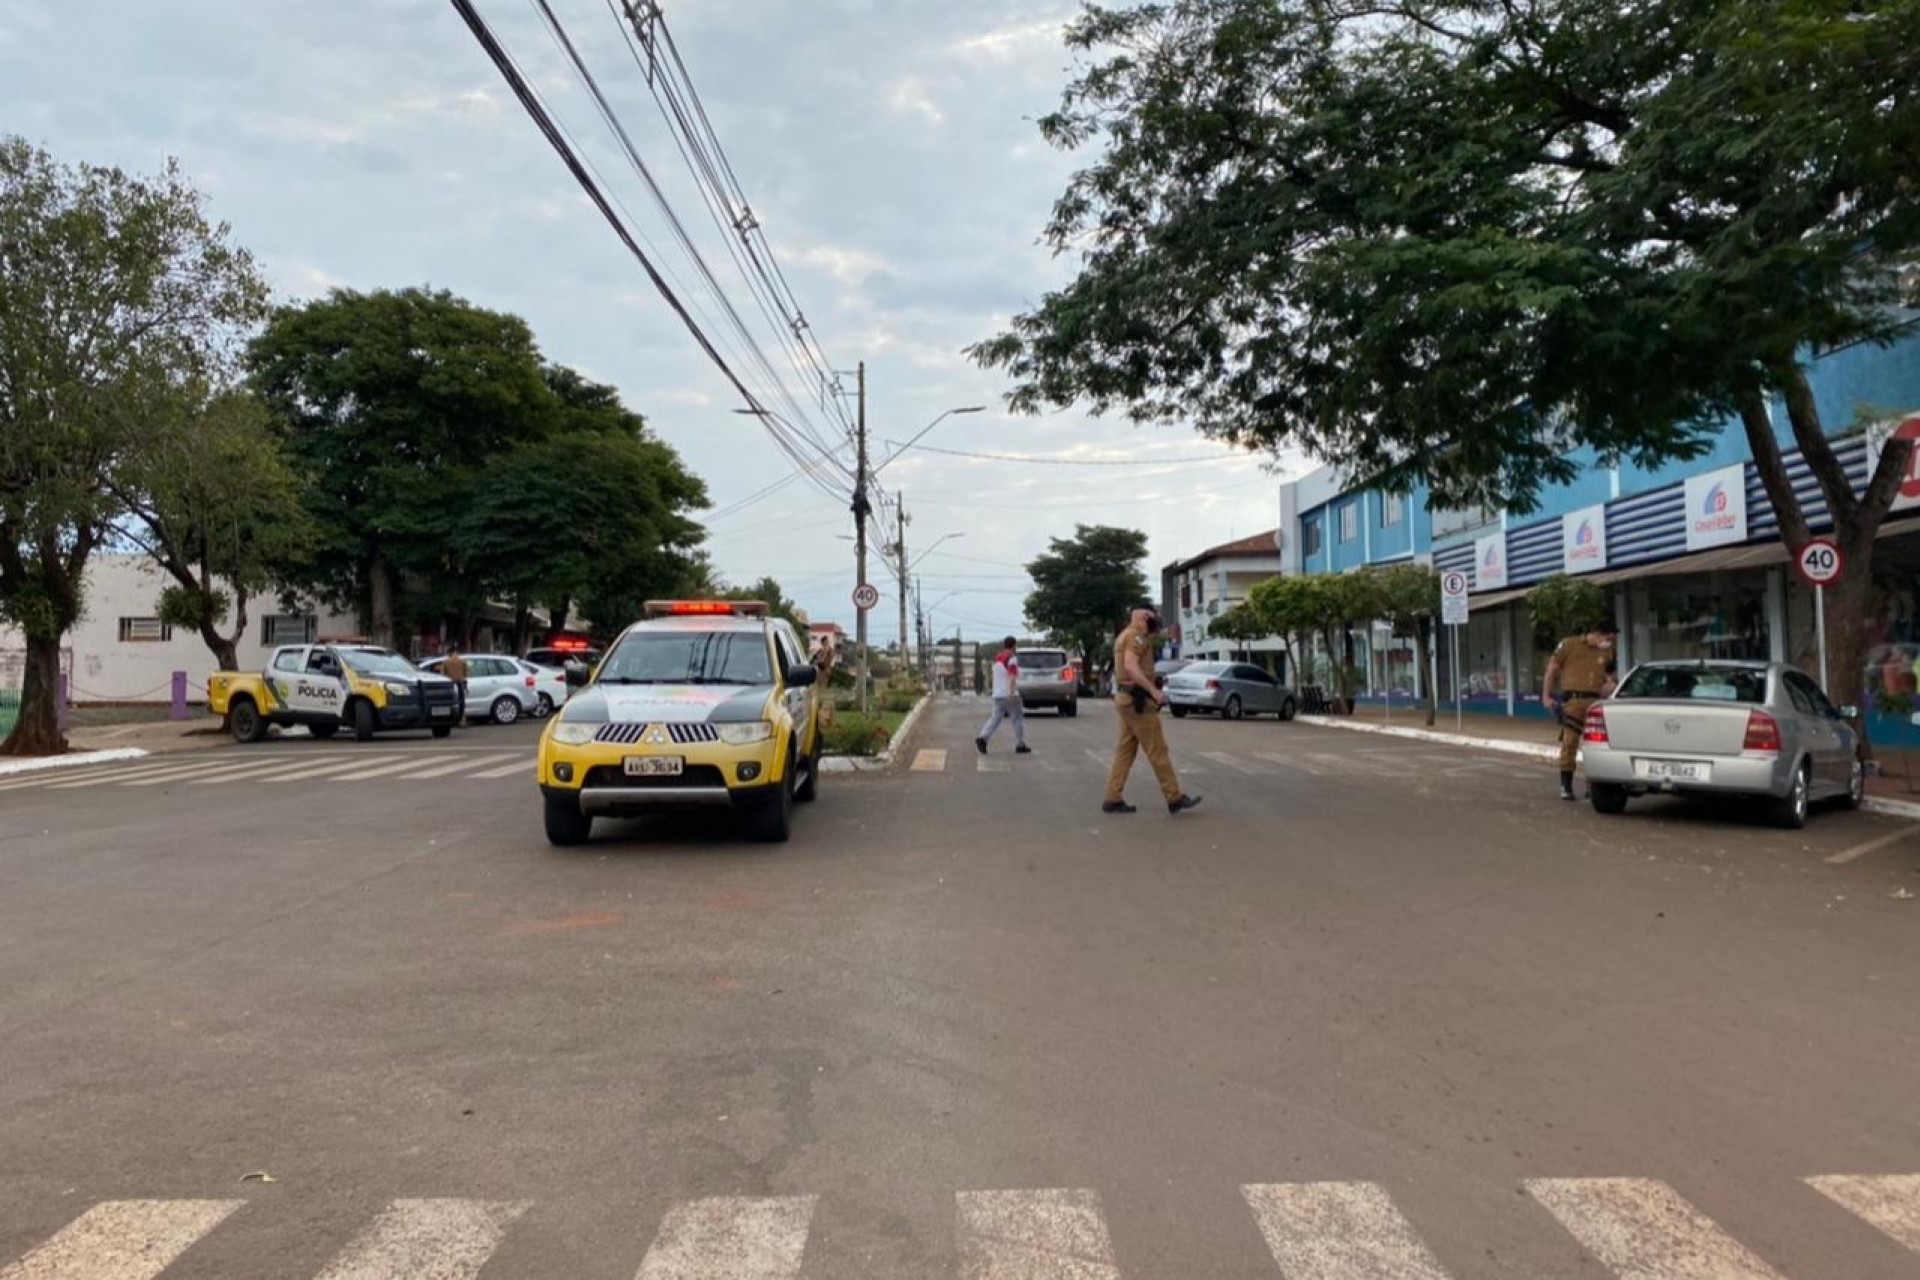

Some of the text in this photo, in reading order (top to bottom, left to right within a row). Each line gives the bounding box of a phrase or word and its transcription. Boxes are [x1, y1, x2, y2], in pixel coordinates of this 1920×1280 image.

[1804, 549, 1834, 569] 40
[1450, 577, 1458, 590] E
[857, 590, 873, 600] 40
